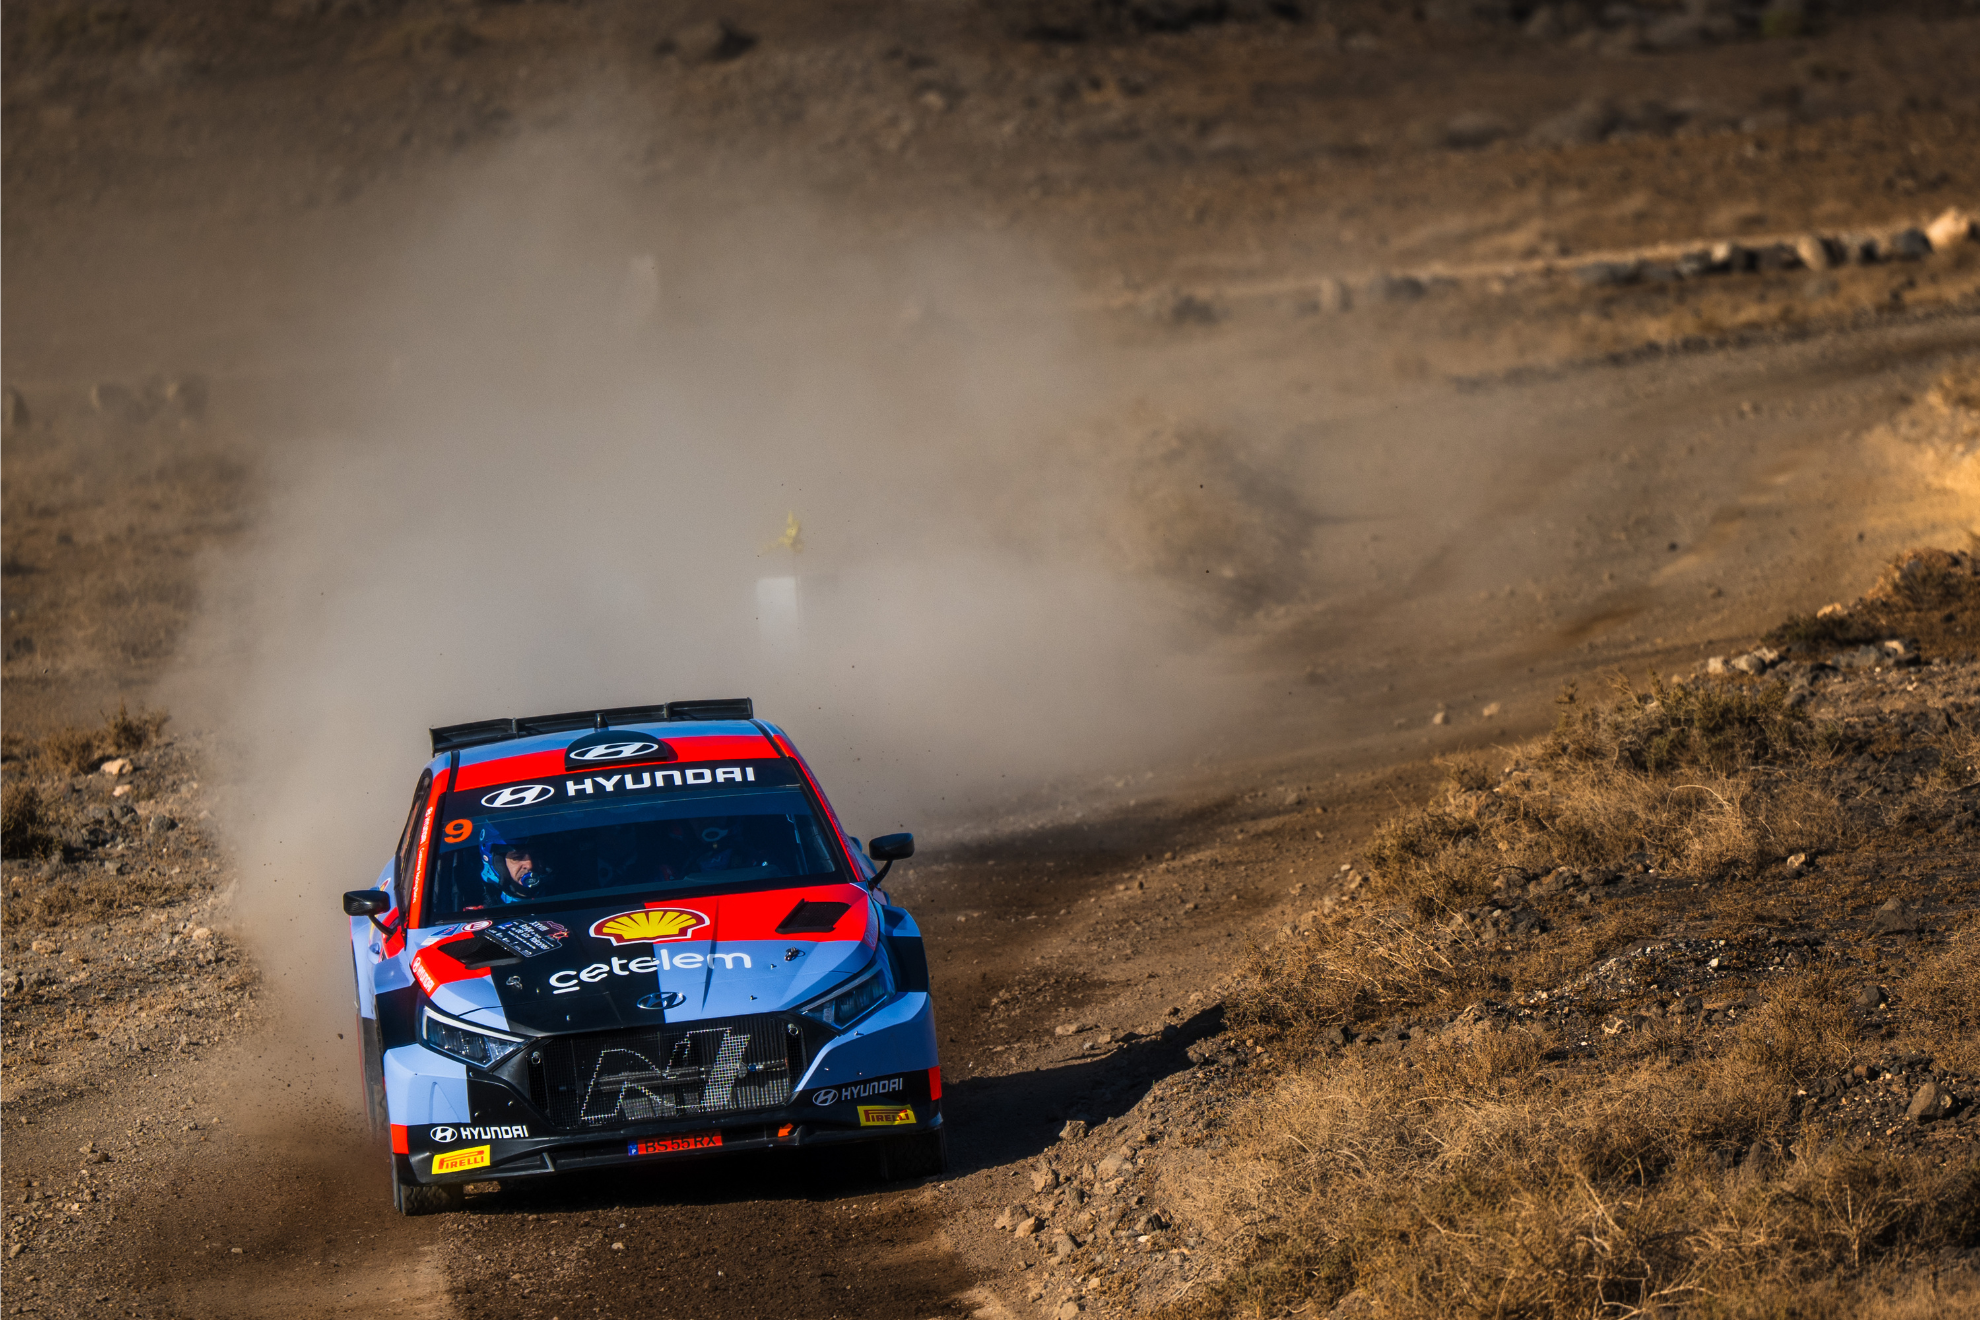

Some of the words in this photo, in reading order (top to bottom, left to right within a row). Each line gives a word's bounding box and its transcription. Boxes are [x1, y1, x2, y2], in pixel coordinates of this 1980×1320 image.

[566, 767, 756, 796] HYUNDAI
[444, 818, 473, 843] 9
[549, 949, 752, 994] cetelem
[842, 1078, 903, 1101] HYUNDAI
[863, 1109, 910, 1123] PIRELLI
[460, 1125, 529, 1140] HYUNDAI
[438, 1150, 485, 1170] PIRELLI
